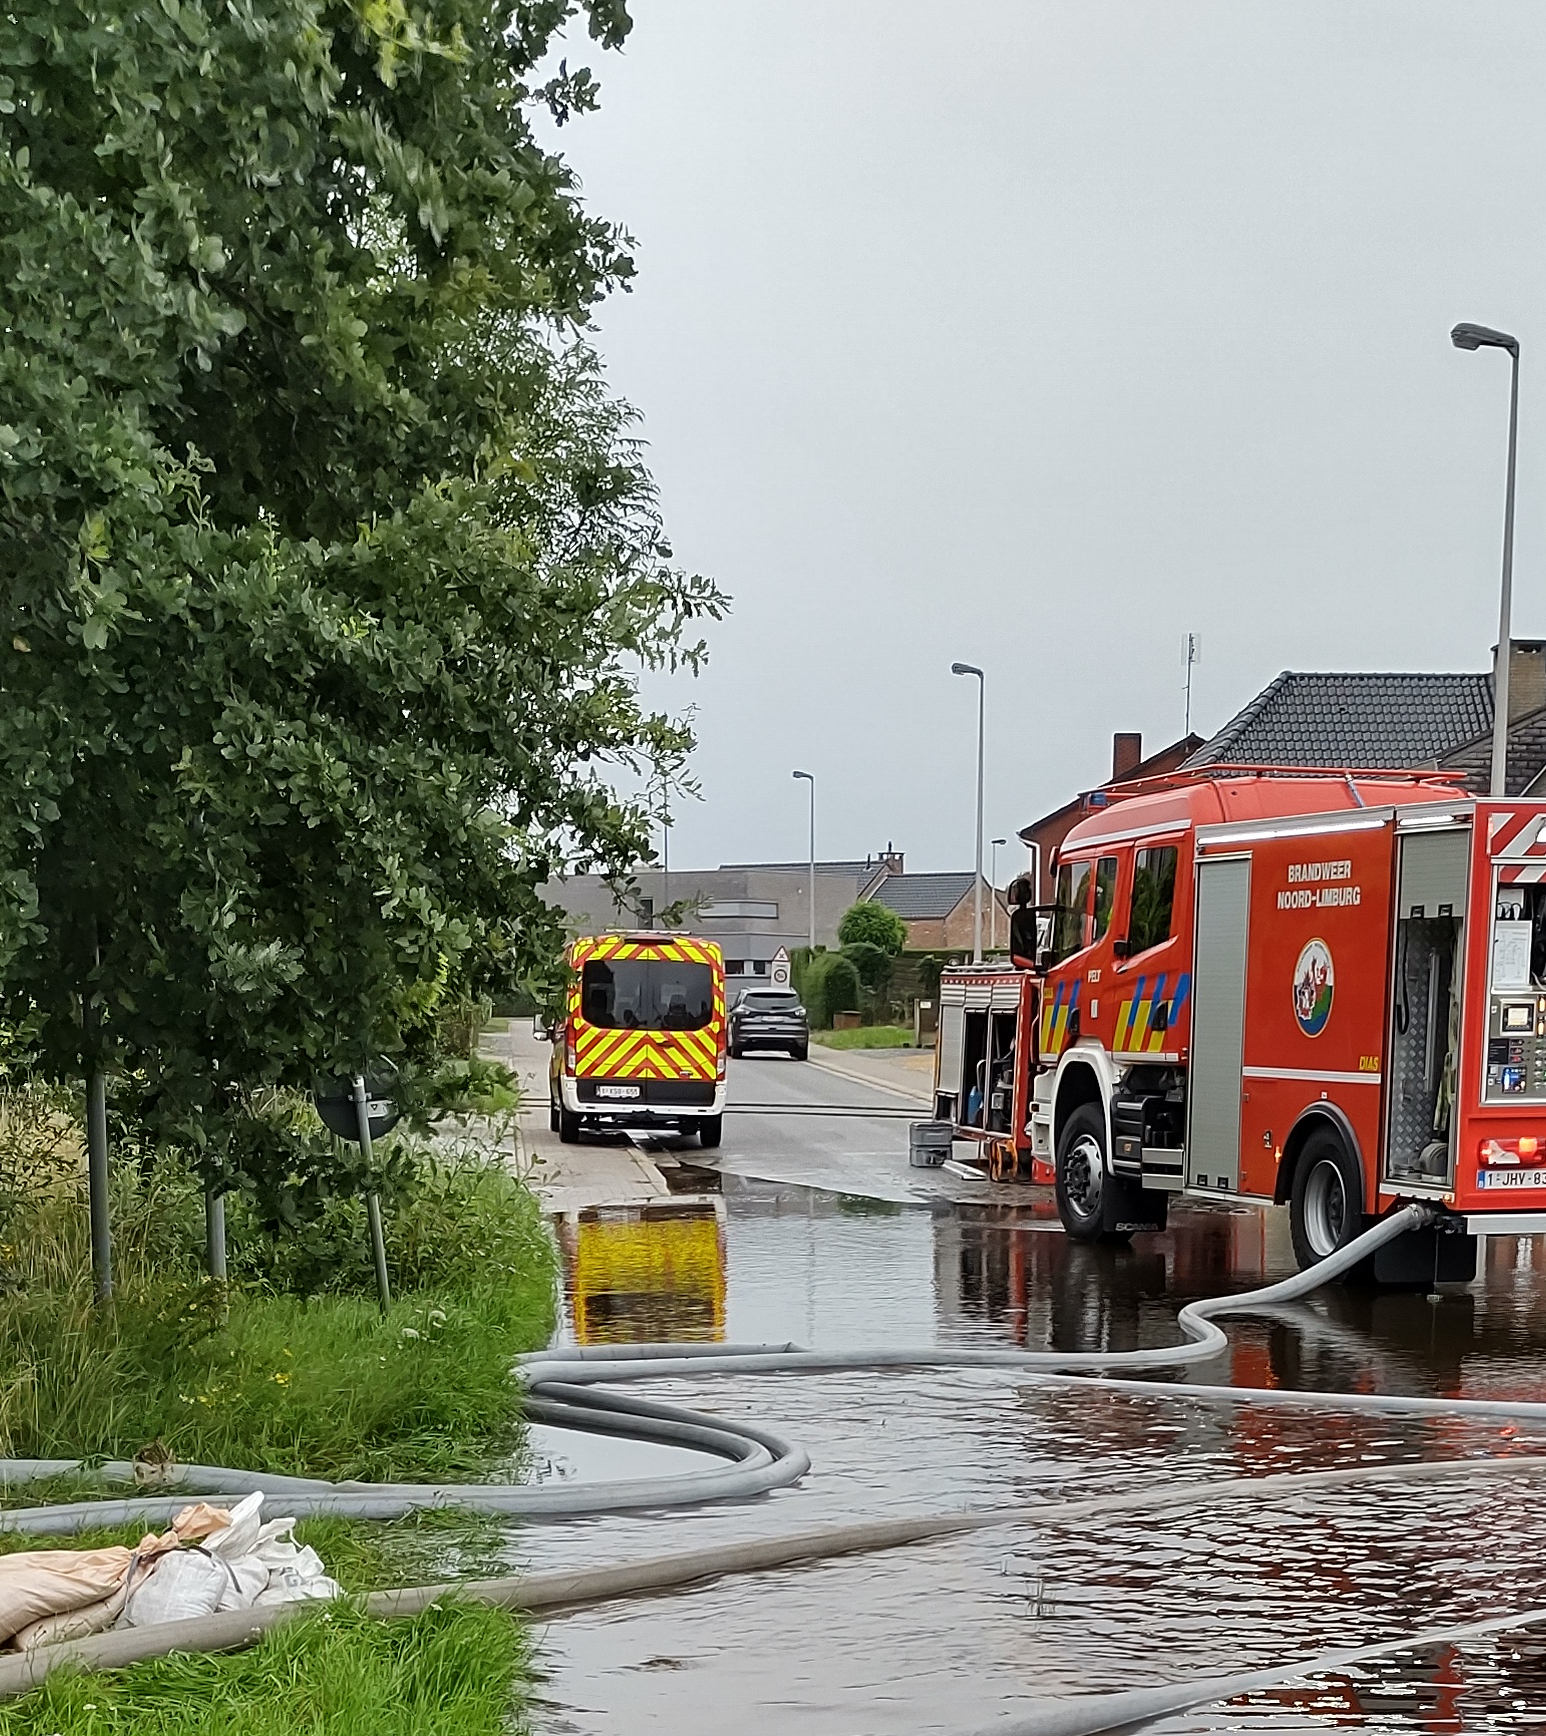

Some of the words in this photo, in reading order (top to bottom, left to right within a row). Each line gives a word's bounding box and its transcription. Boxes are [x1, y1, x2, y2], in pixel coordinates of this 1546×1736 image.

[1287, 860, 1352, 883] BRANDWEER
[1277, 886, 1361, 910] NOORD-LIMBURG
[1359, 1056, 1379, 1071] DIAS
